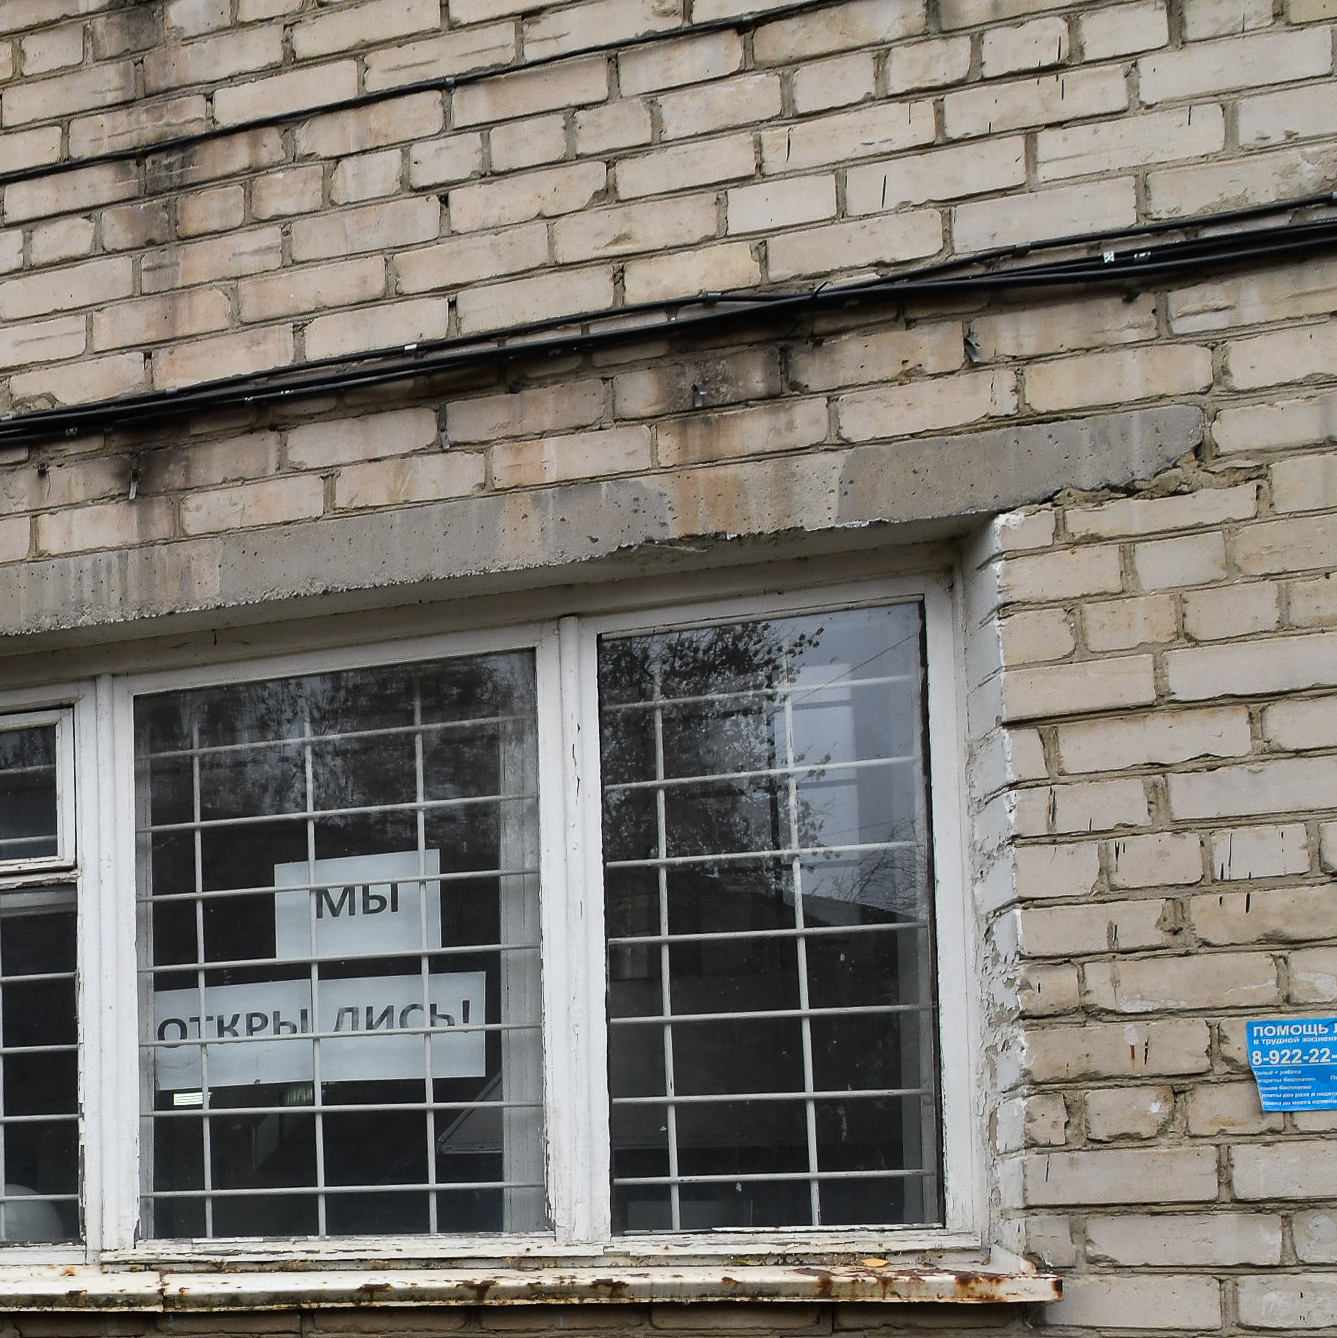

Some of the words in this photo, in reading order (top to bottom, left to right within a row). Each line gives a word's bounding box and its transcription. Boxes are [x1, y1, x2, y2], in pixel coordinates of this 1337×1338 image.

[315, 882, 399, 919] МЫ
[1252, 1023, 1329, 1037] ПОМОЩЬ
[1261, 1036, 1300, 1046] трудной
